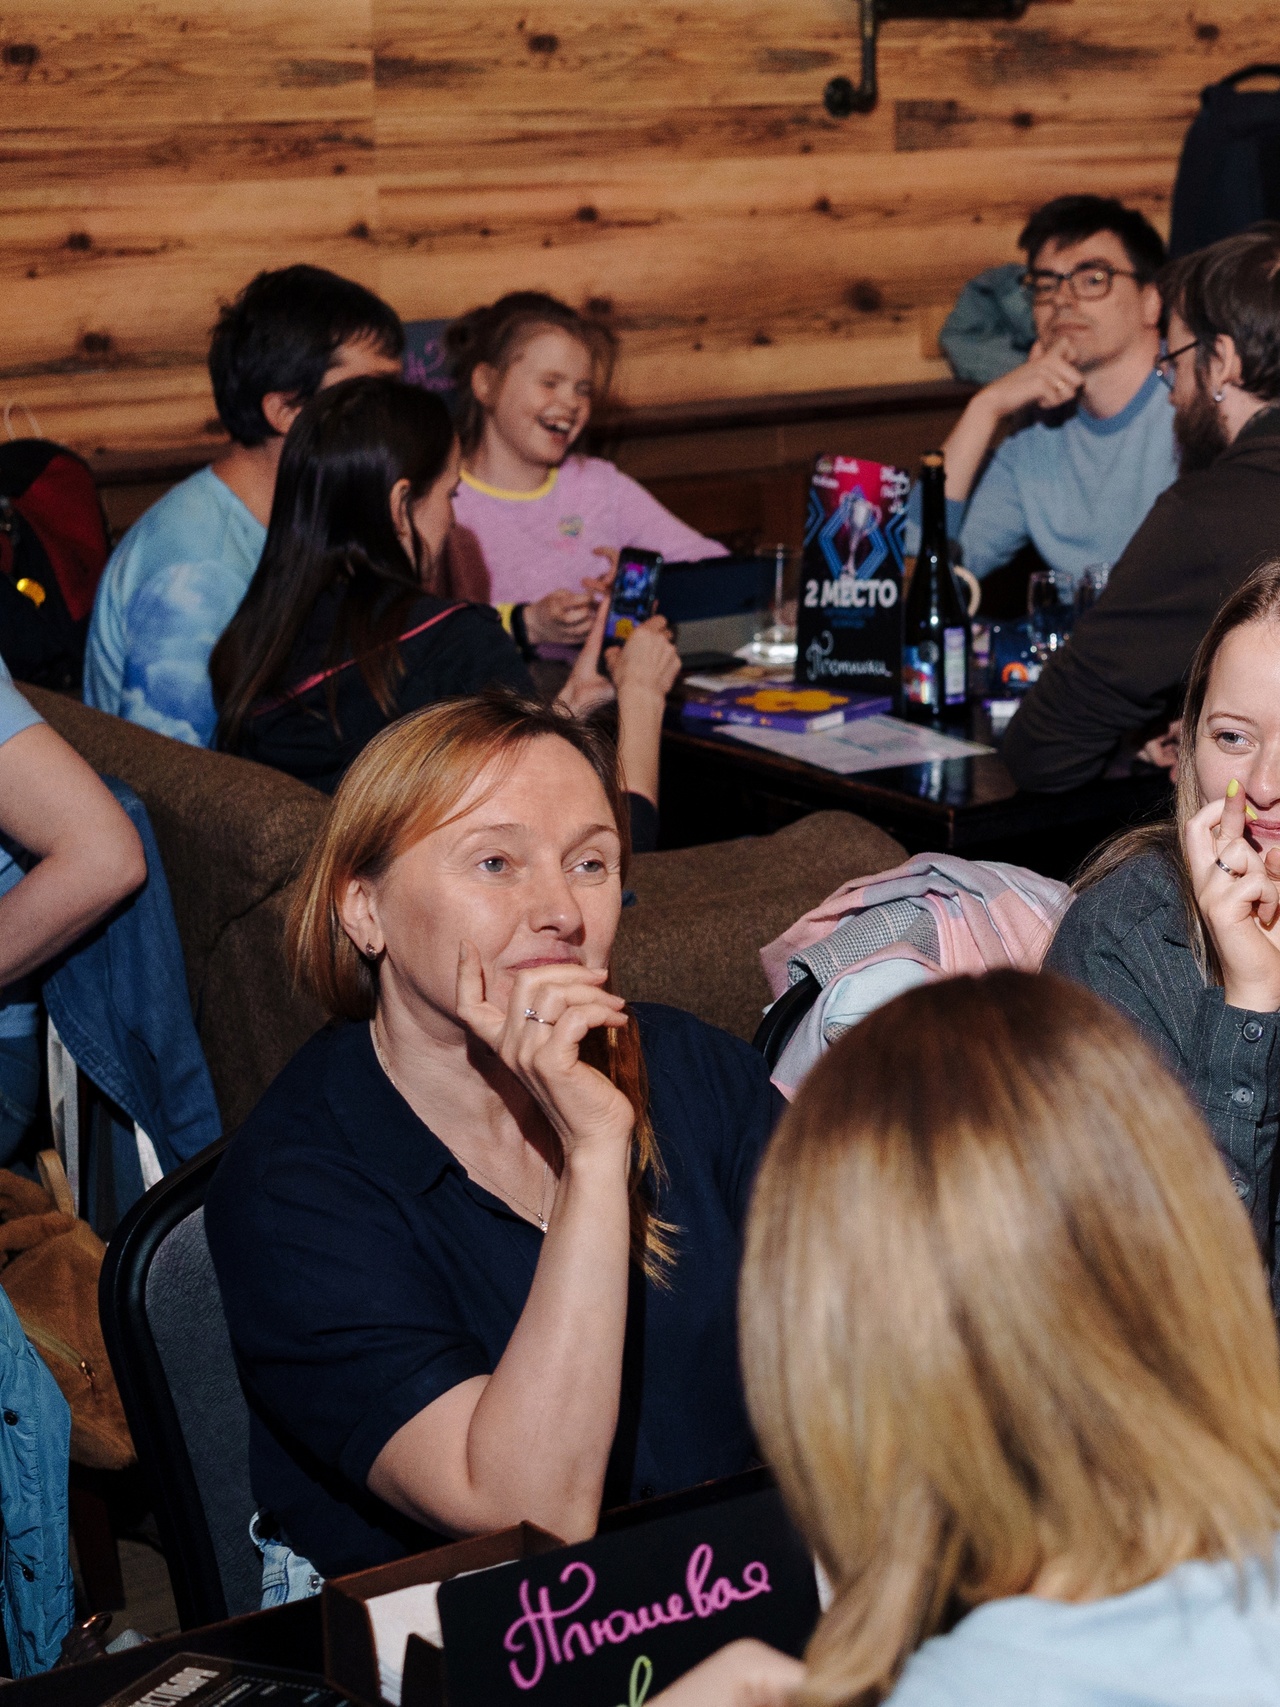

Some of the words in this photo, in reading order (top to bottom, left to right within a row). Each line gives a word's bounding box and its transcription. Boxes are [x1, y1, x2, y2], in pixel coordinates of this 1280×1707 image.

[804, 579, 819, 608] 2
[820, 579, 898, 608] МЕСТО
[503, 1543, 772, 1690] Плюшевая
